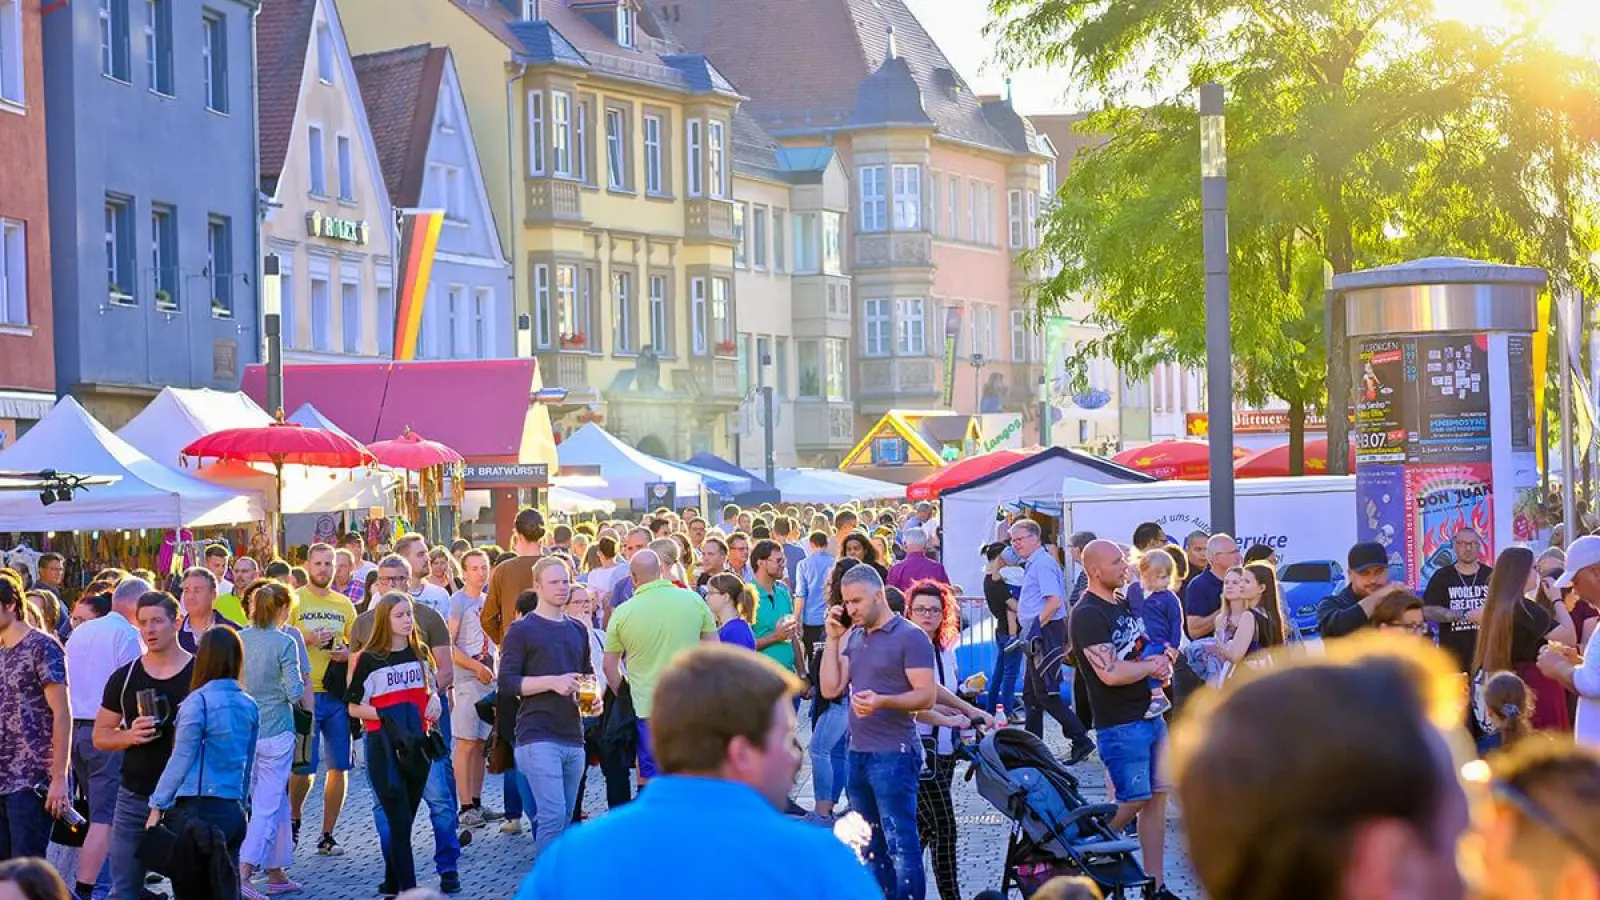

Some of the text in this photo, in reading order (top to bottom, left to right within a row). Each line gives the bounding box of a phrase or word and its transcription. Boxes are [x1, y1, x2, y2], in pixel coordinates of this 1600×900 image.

[478, 464, 545, 476] BRATWÜRSTE
[1416, 492, 1450, 509] DON
[1454, 484, 1493, 504] JUAN
